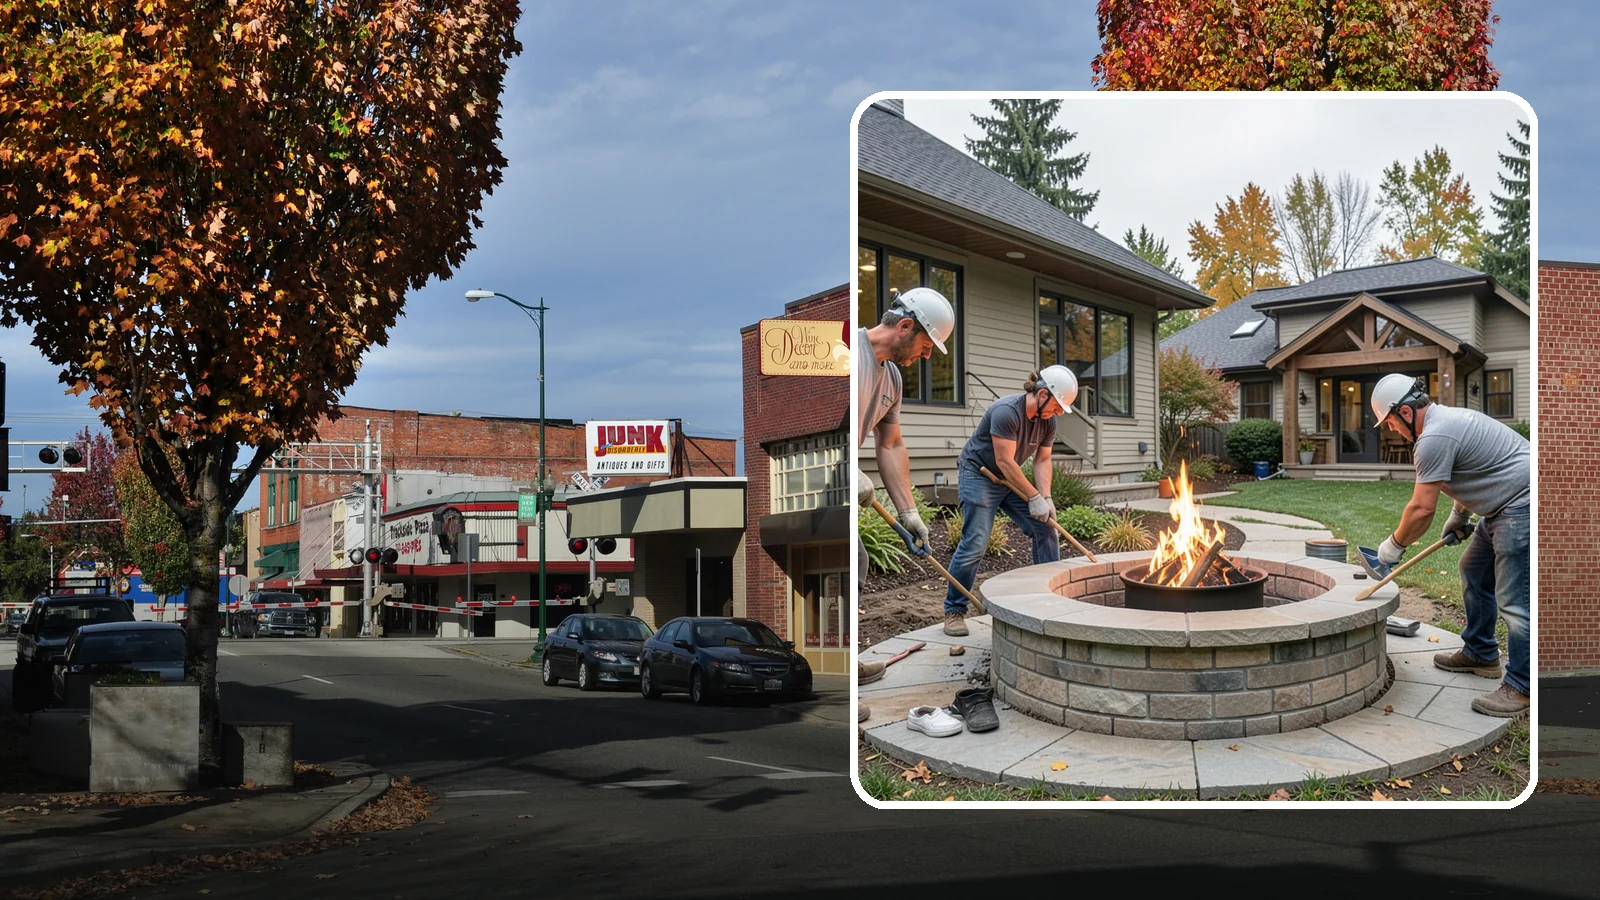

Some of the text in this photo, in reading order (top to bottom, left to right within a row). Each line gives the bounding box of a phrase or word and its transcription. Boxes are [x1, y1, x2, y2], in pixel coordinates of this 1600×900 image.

[596, 425, 664, 457] JUNK
[607, 446, 646, 454] DISORDERLY
[597, 460, 665, 470] ANTIQUES AND GIFTS
[414, 519, 429, 535] Pizza
